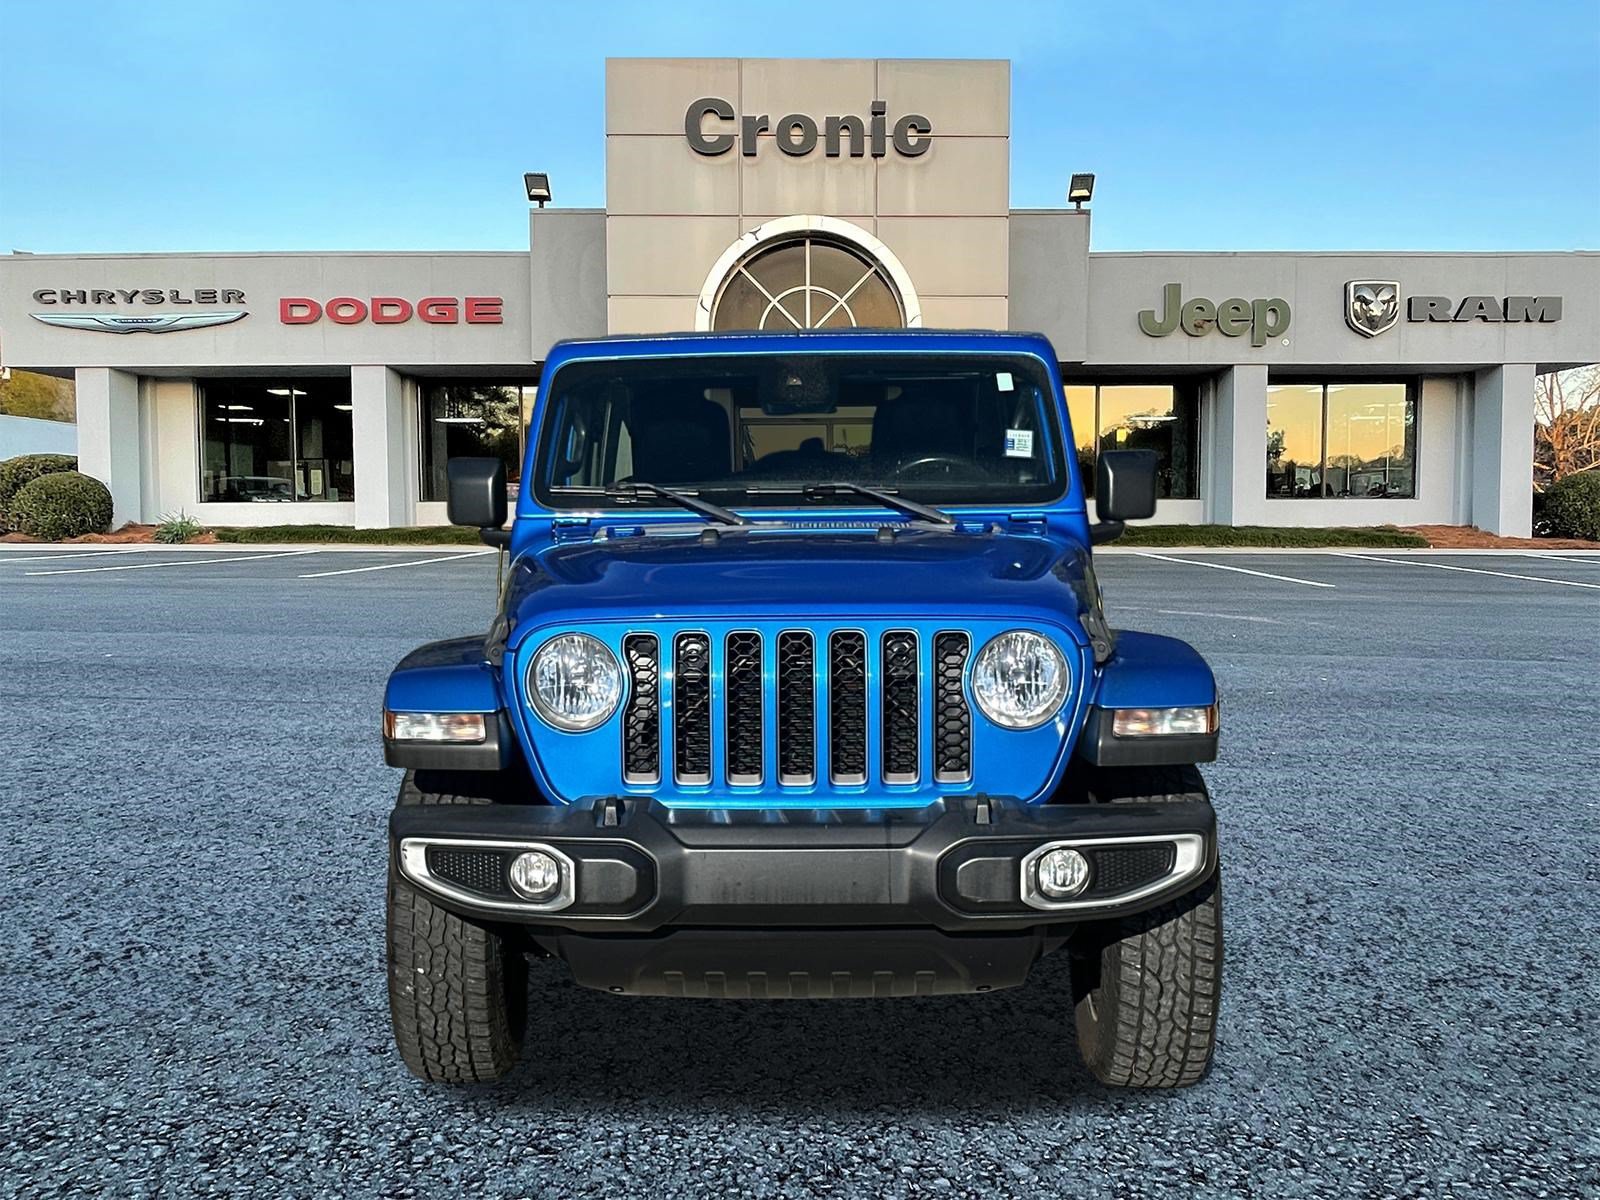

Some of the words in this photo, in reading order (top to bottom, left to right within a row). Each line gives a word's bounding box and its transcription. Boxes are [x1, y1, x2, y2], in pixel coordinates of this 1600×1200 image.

[685, 97, 932, 157] Cronic
[32, 289, 247, 305] CHRYSLER
[280, 297, 503, 324] DODGE
[1407, 296, 1562, 322] RAM
[1138, 283, 1291, 347] Jeep
